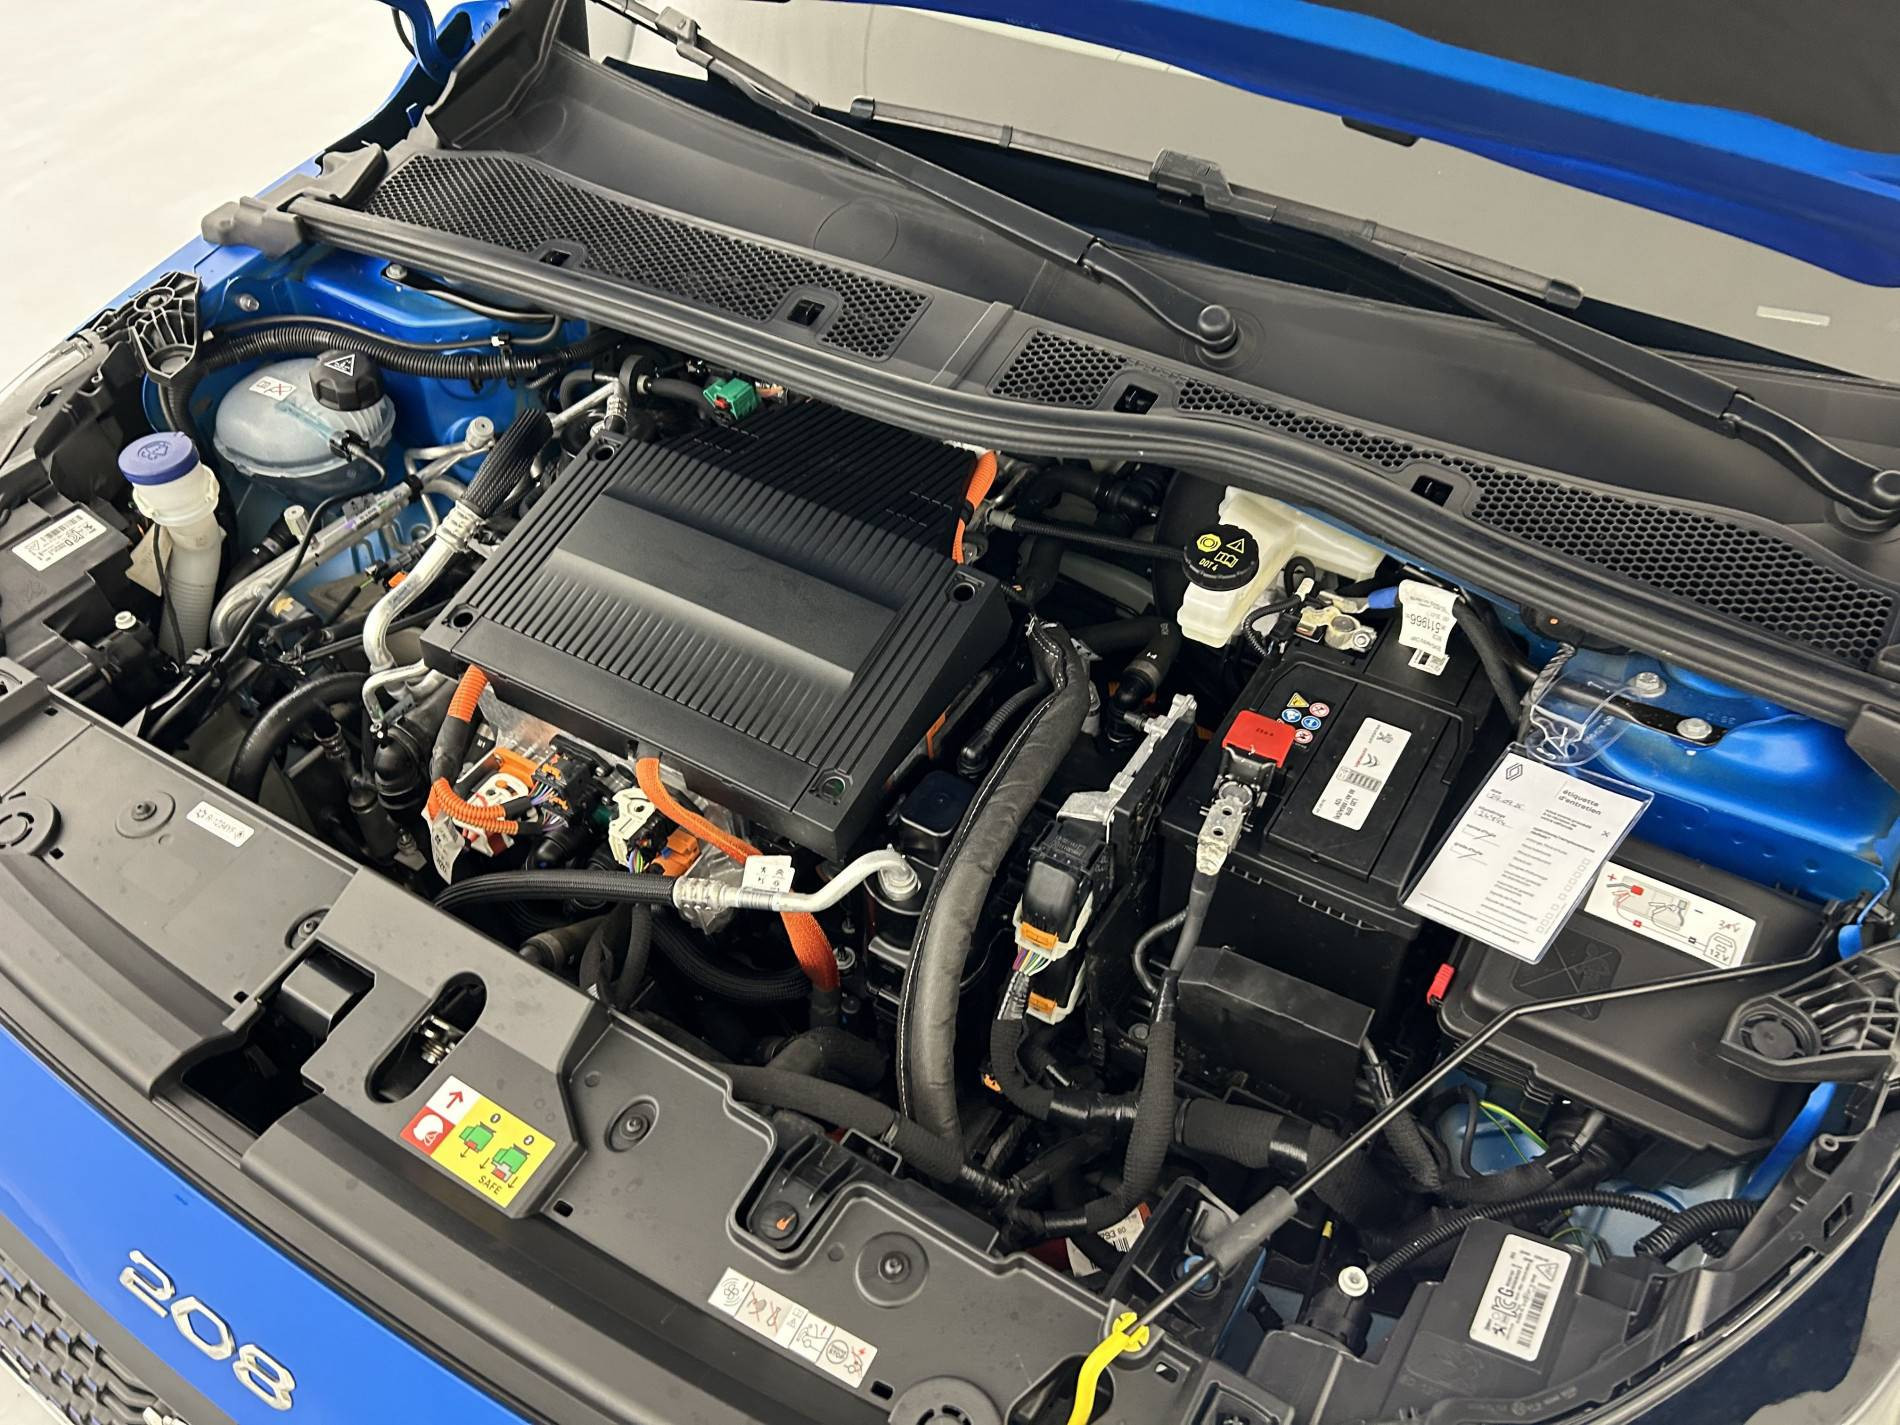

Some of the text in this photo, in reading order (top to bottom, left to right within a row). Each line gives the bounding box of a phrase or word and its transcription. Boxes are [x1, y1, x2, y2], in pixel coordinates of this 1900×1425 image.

[1199, 558, 1213, 568] DOT
[478, 1175, 503, 1195] SAFE
[119, 1249, 297, 1412] 208
